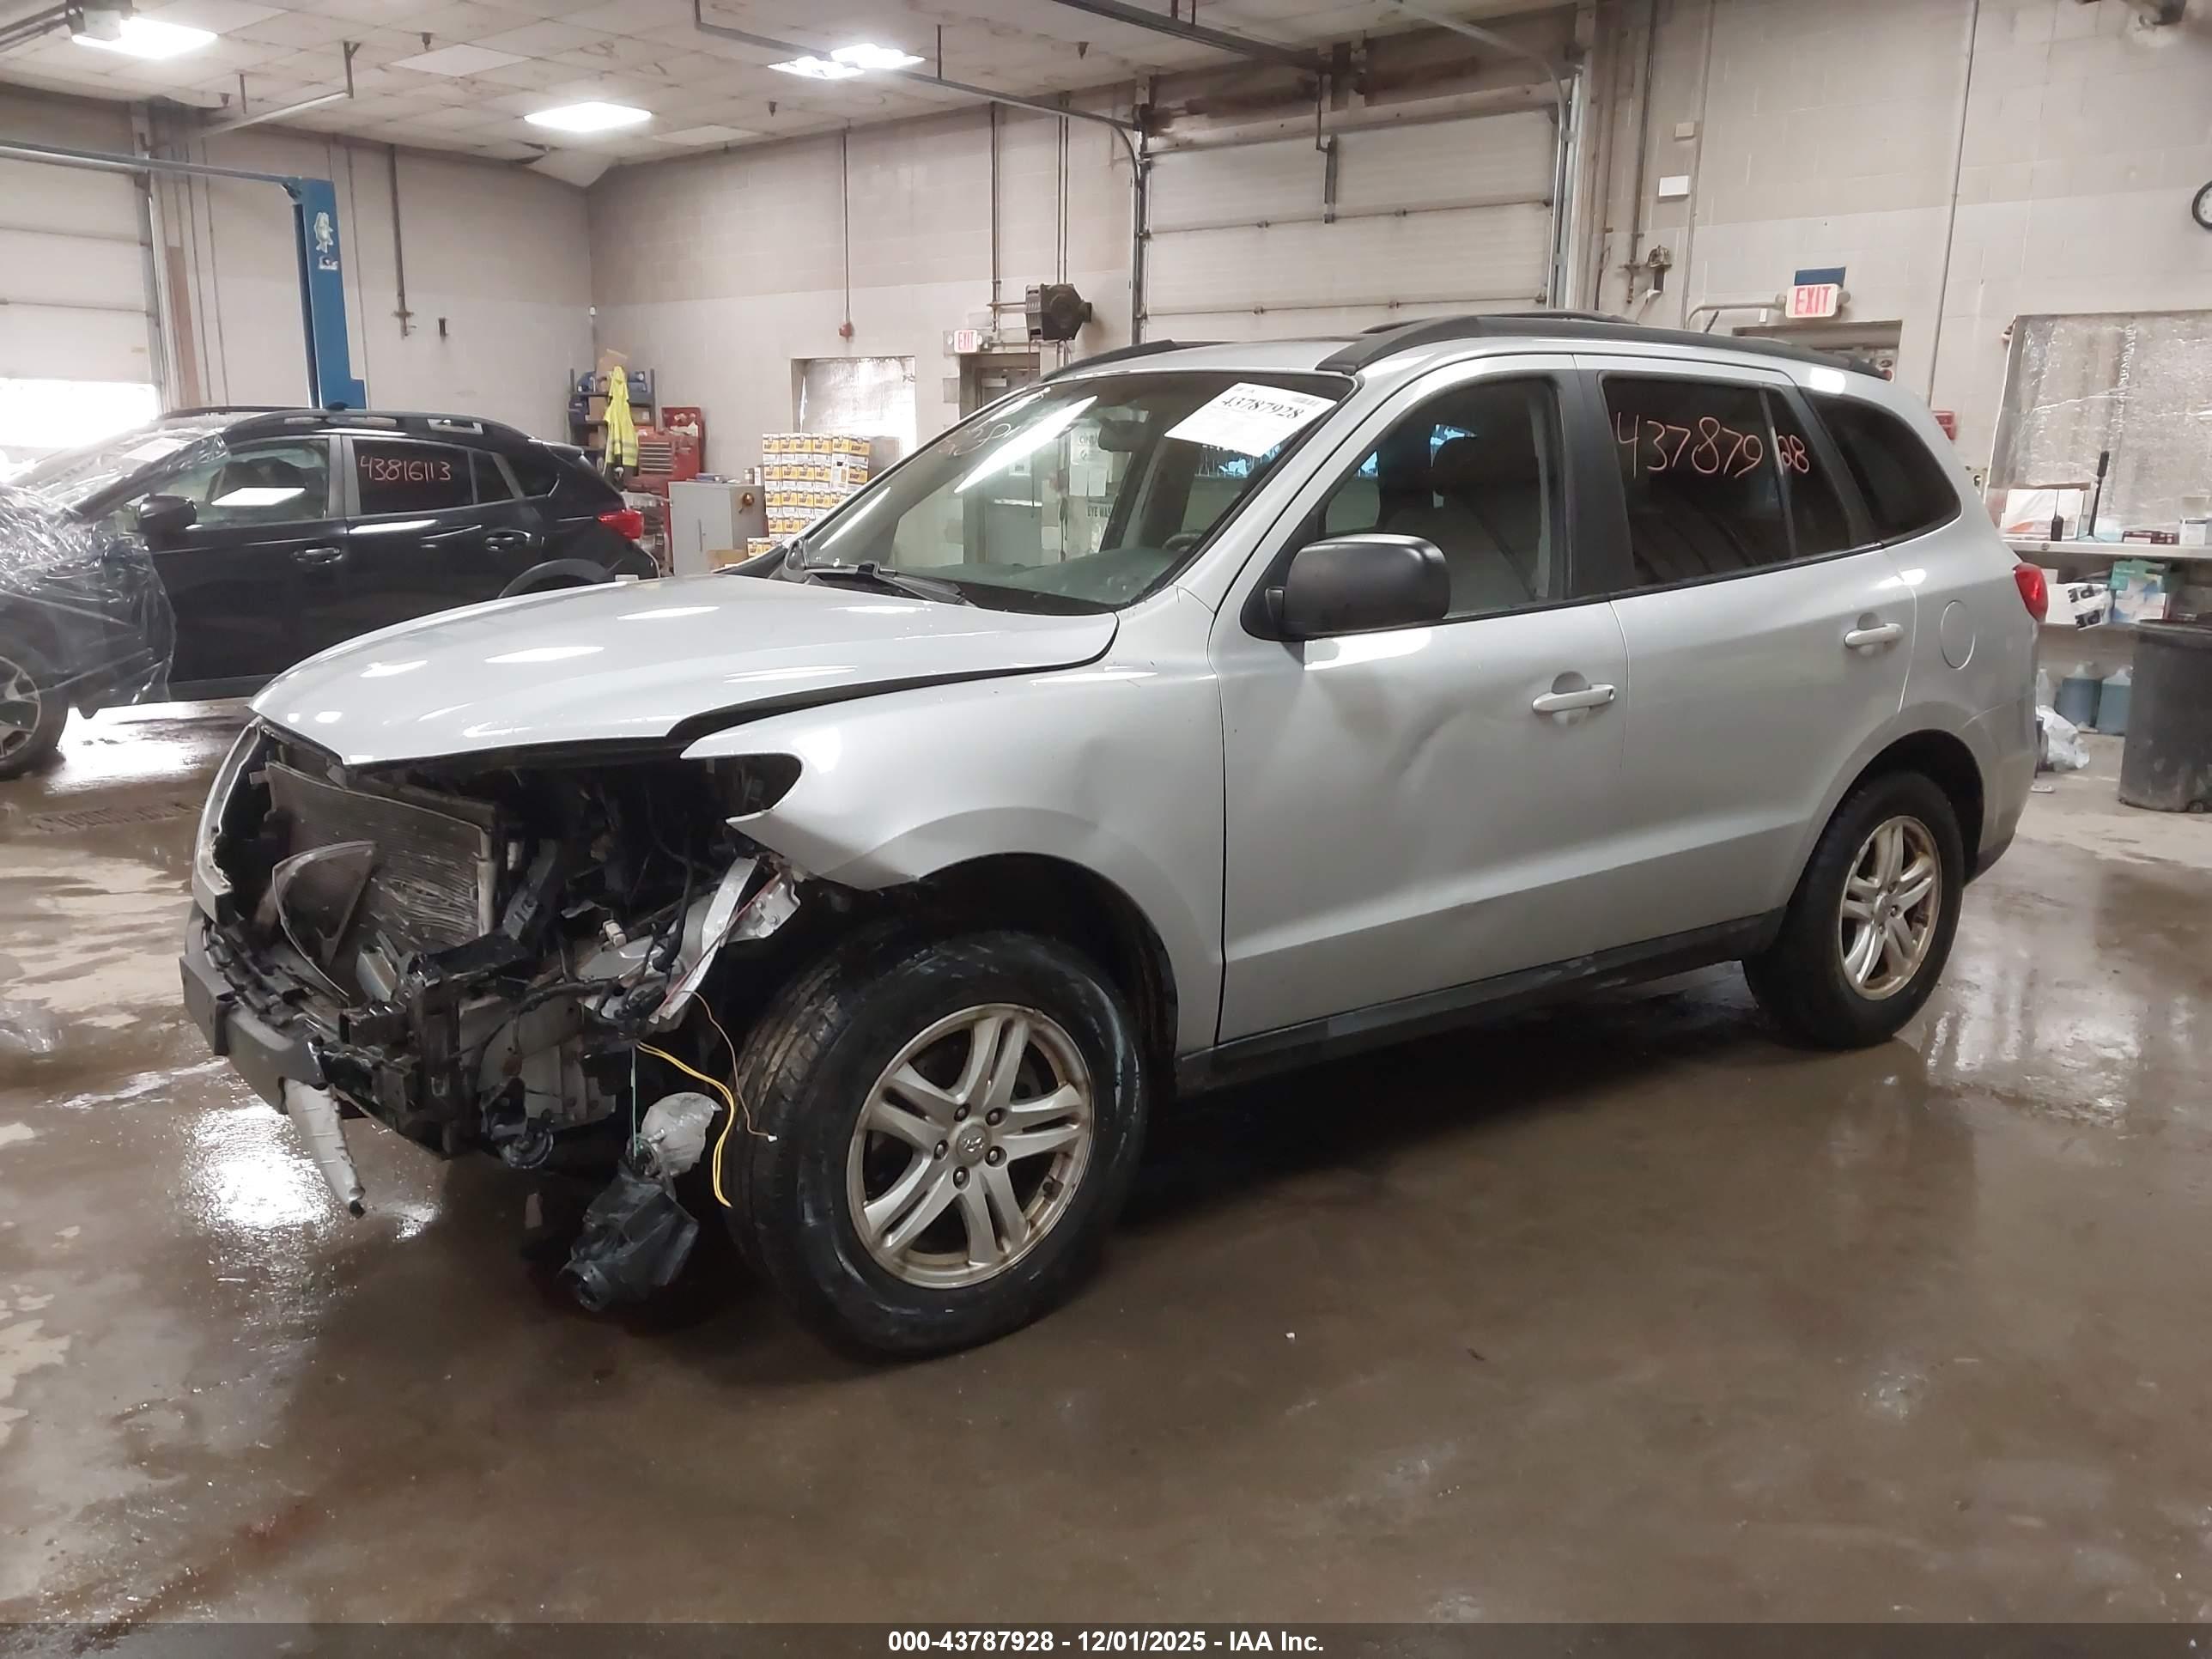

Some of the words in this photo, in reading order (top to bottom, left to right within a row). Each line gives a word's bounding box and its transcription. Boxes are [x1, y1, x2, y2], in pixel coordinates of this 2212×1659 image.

[1794, 286, 1831, 315] EXIT
[957, 331, 974, 350] EXIT
[1221, 396, 1304, 419] 43787928
[360, 455, 452, 481] 43816113
